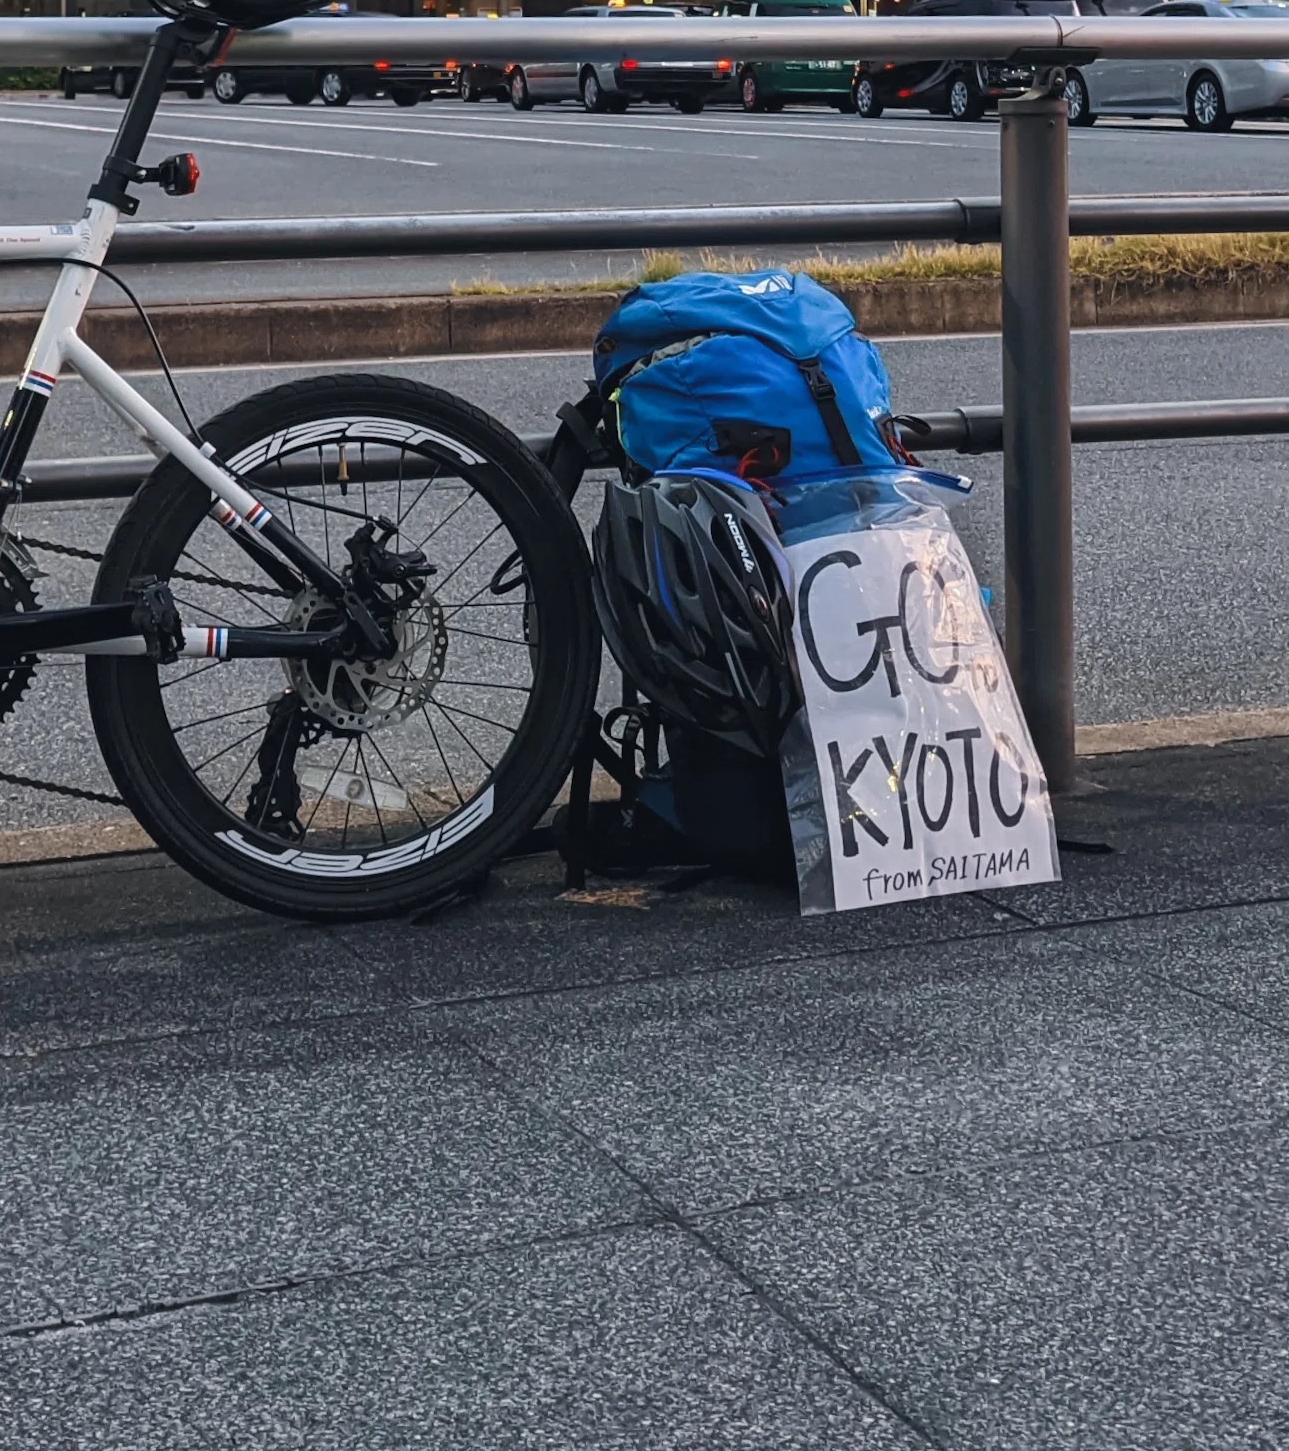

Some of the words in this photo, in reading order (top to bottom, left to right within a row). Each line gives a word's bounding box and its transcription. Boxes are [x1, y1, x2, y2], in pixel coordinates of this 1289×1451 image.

[798, 550, 960, 697] GO
[827, 727, 1029, 857] KYOTO
[862, 867, 923, 900] from
[927, 847, 1030, 886] SAITAMA
